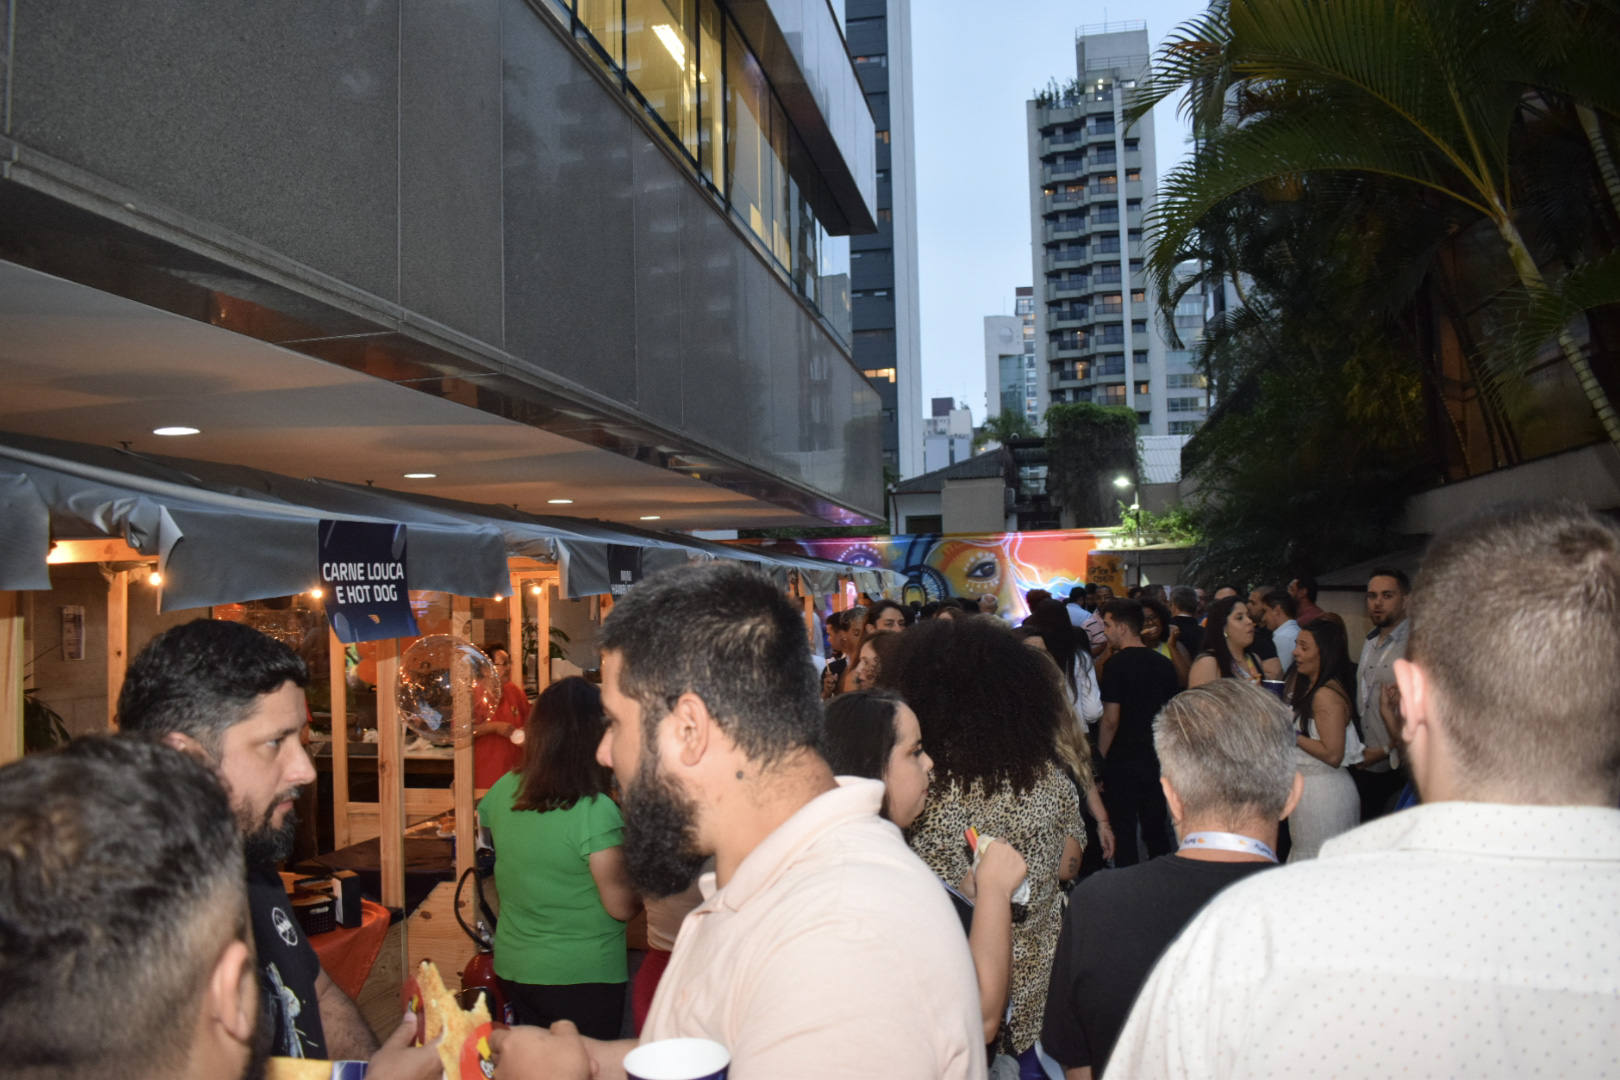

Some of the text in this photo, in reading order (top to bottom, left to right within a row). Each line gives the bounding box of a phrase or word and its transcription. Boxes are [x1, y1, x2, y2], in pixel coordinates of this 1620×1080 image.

[322, 562, 404, 581] CARNE LOUCA
[335, 584, 397, 604] E HOT DOG
